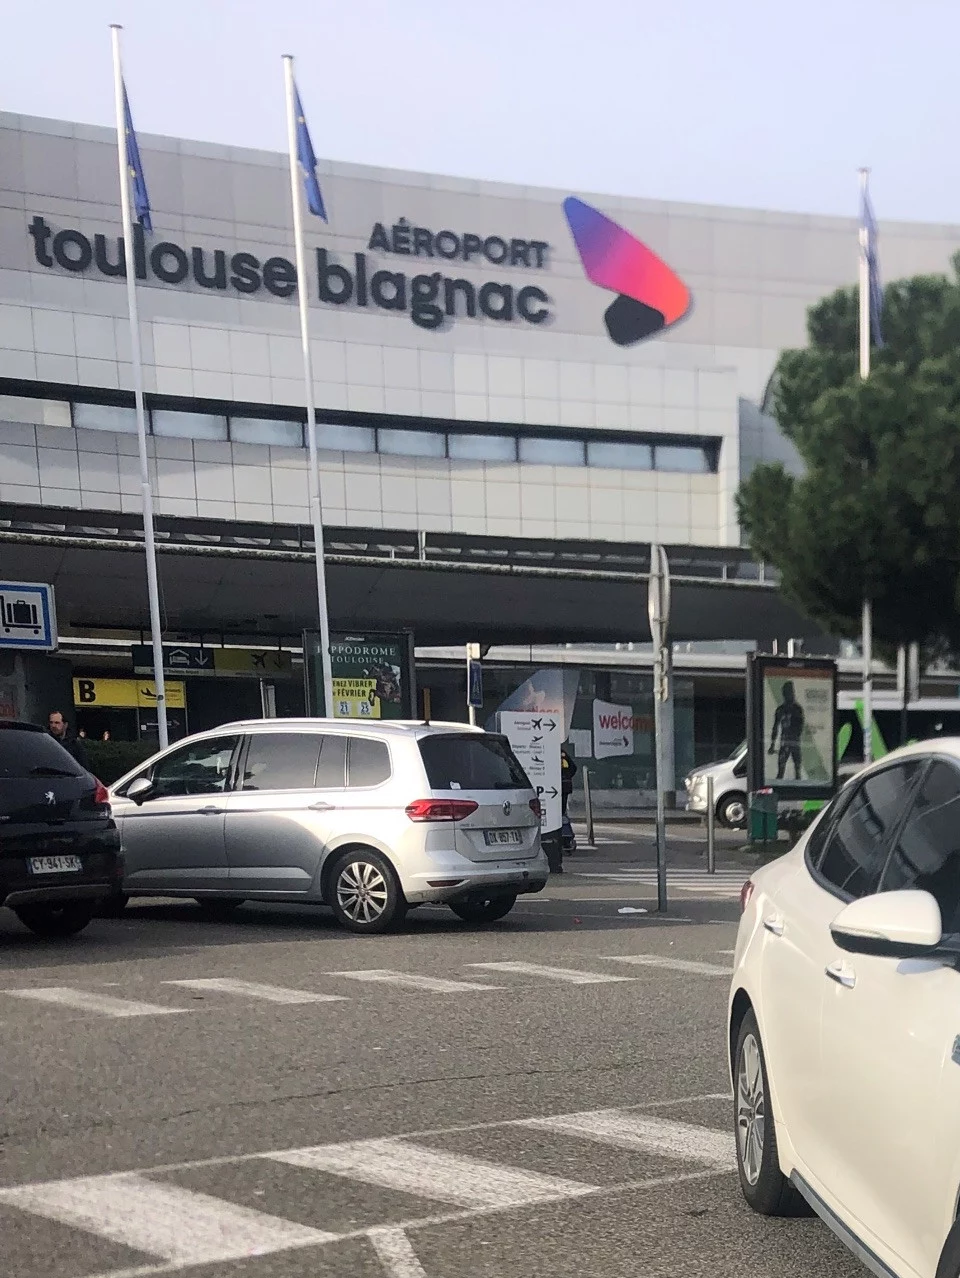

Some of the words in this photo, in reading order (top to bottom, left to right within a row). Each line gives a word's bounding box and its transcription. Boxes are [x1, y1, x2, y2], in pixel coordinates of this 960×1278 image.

[368, 217, 548, 267] AÉROPORT
[28, 216, 297, 297] toulouse
[315, 247, 549, 329] blagnac
[79, 679, 96, 702] B
[337, 688, 366, 697] FÉVRIER
[536, 786, 545, 798] P
